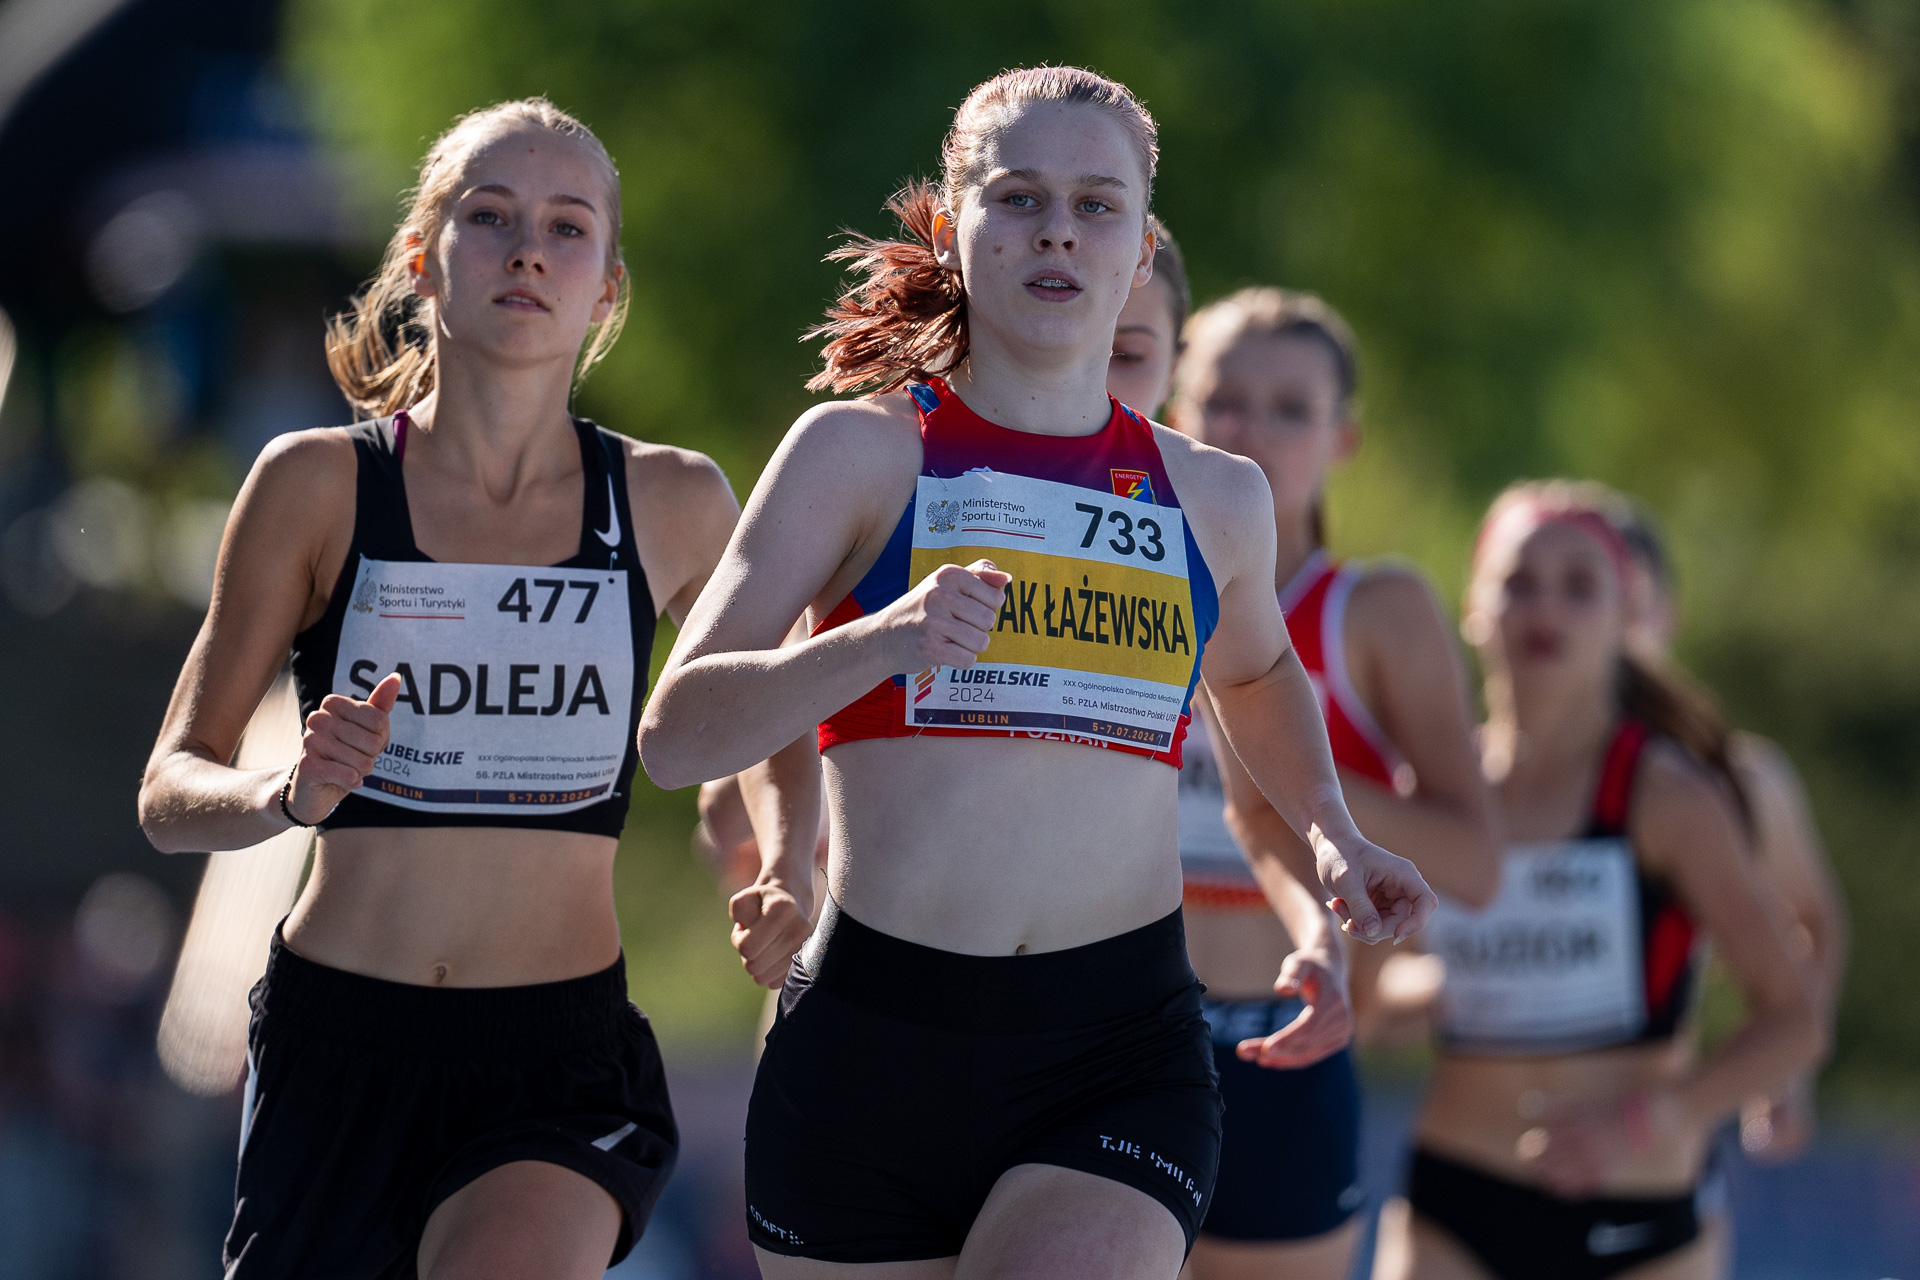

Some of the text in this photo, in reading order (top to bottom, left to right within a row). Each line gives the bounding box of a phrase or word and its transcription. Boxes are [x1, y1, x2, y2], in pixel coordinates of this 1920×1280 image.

[962, 498, 1026, 513] Ministerstwo
[961, 511, 1046, 530] Sportu i Turystyki
[1075, 502, 1166, 562] 733
[379, 583, 445, 596] Ministerstwo
[379, 596, 412, 609] Sportu
[420, 598, 466, 610] Turystyki
[497, 578, 600, 624] 477
[1043, 574, 1190, 657] ŁAŻEWSKA
[349, 659, 611, 717] SADLEJA
[950, 669, 1051, 688] LUBELSKIE
[949, 687, 996, 704] 2024
[1062, 679, 1077, 688] XXX
[1077, 681, 1124, 695] Ogólnopolska
[1125, 687, 1157, 700] Olimpiada
[960, 713, 1010, 725] LUBLIN
[1062, 696, 1178, 723] 56. PZLA Mistrzostwa Polski U18
[1092, 722, 1156, 743] 5-7.07.2024
[384, 743, 465, 766] UBELSKIE
[374, 756, 411, 777] 2024
[476, 770, 490, 780] 56.
[493, 770, 515, 780] PZLA
[517, 770, 574, 781] Mistrzostwa
[576, 769, 600, 780] Polski
[381, 780, 424, 800] LUBLIN
[508, 789, 592, 804] 5-7.07.2024
